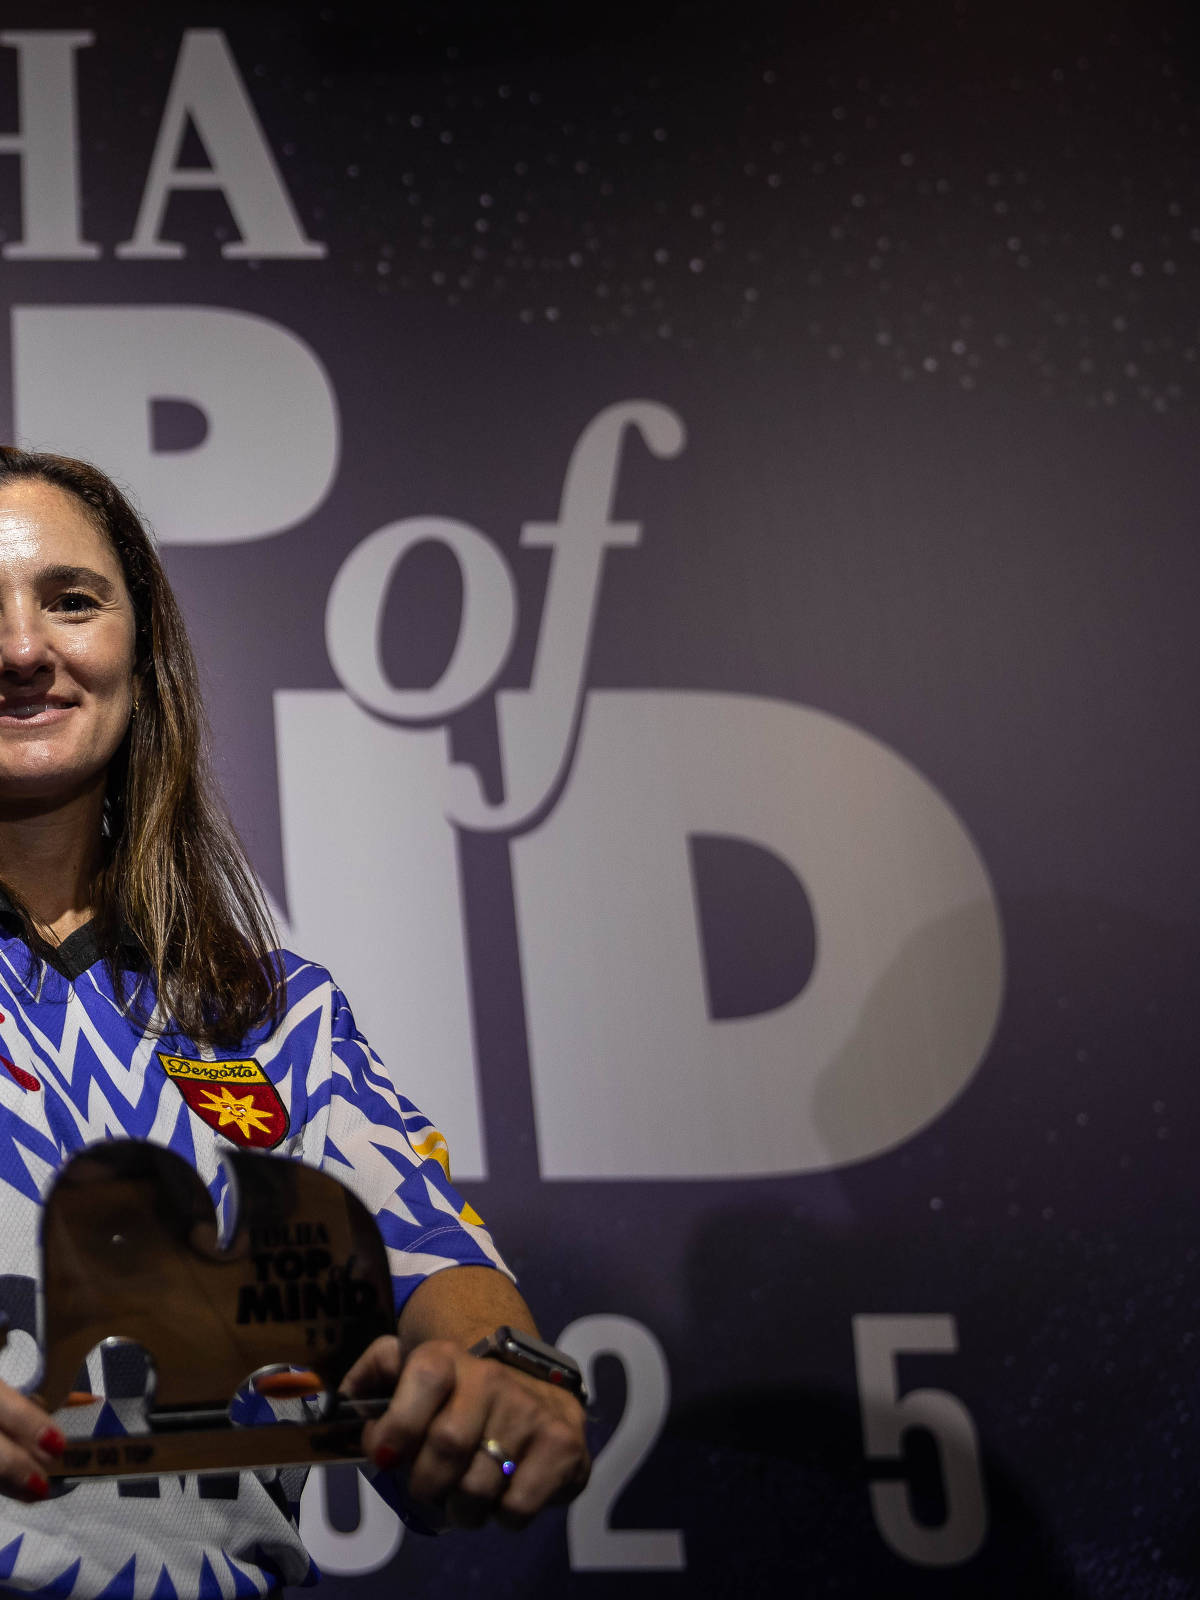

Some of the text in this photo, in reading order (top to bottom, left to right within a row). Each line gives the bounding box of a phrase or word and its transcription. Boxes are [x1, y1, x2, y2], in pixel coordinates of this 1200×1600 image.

[324, 400, 684, 831] of
[253, 1250, 333, 1283] TOP
[236, 1279, 378, 1325] MIND
